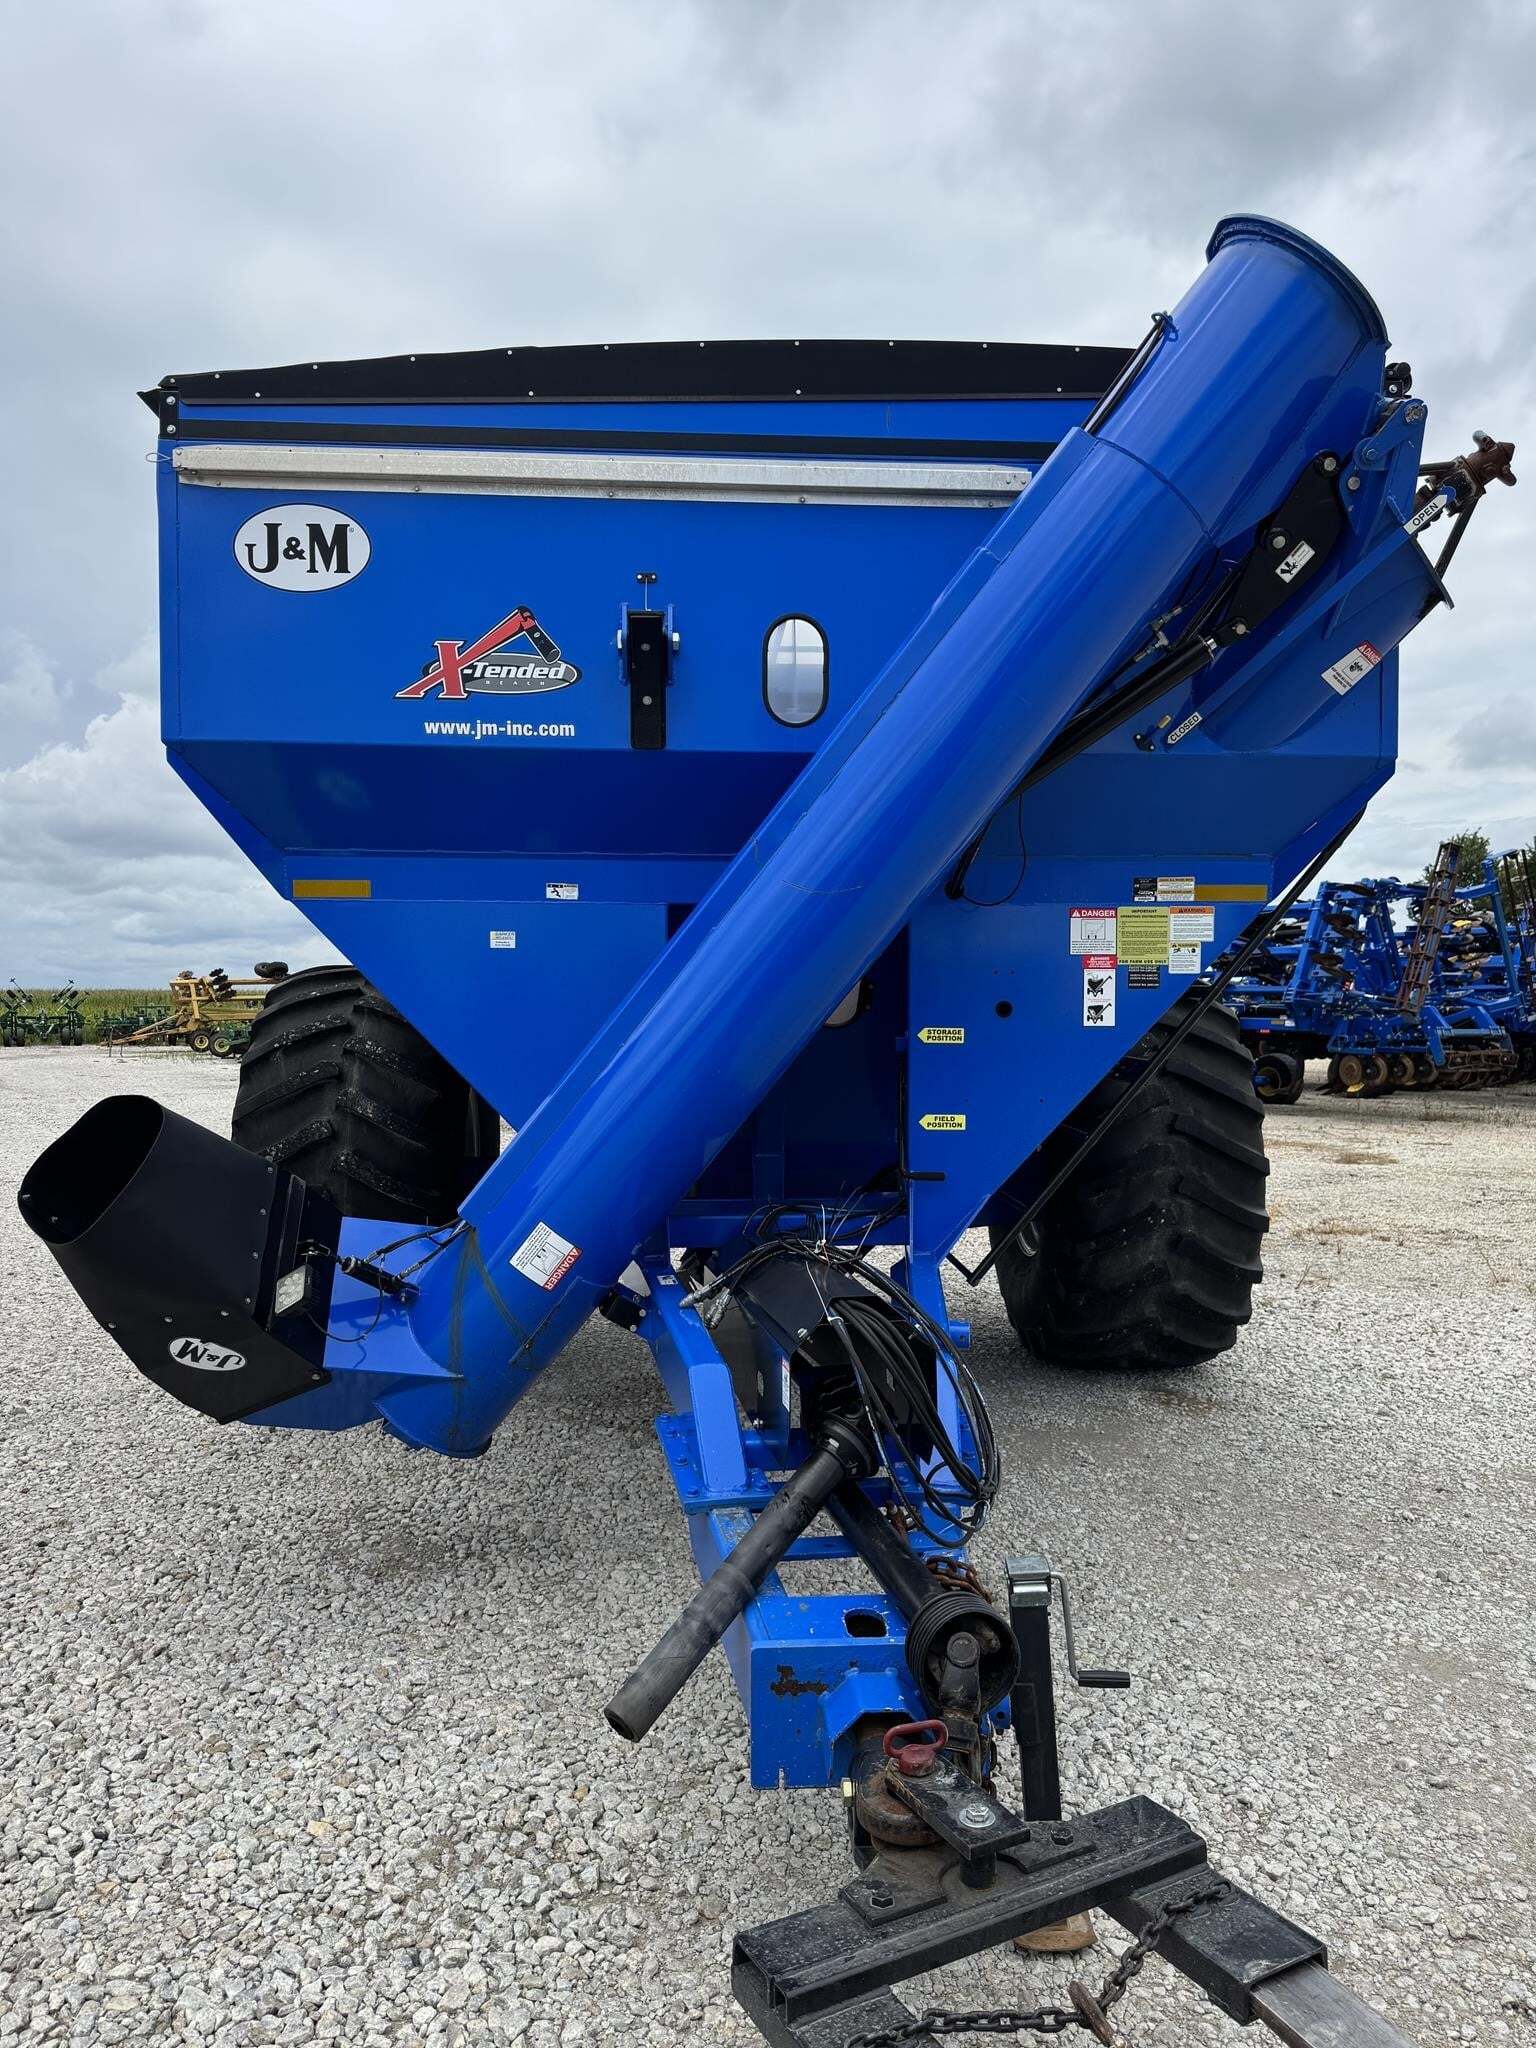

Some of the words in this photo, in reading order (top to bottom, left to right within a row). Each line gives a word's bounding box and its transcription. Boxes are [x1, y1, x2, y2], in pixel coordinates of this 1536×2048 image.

[1412, 502, 1439, 526] OPEN
[424, 719, 576, 740] www.jm-inc.com
[1170, 715, 1199, 741] CLOSED
[1081, 909, 1116, 917] DANGER
[545, 1254, 576, 1290] DANGER
[174, 1340, 243, 1368] J&M
